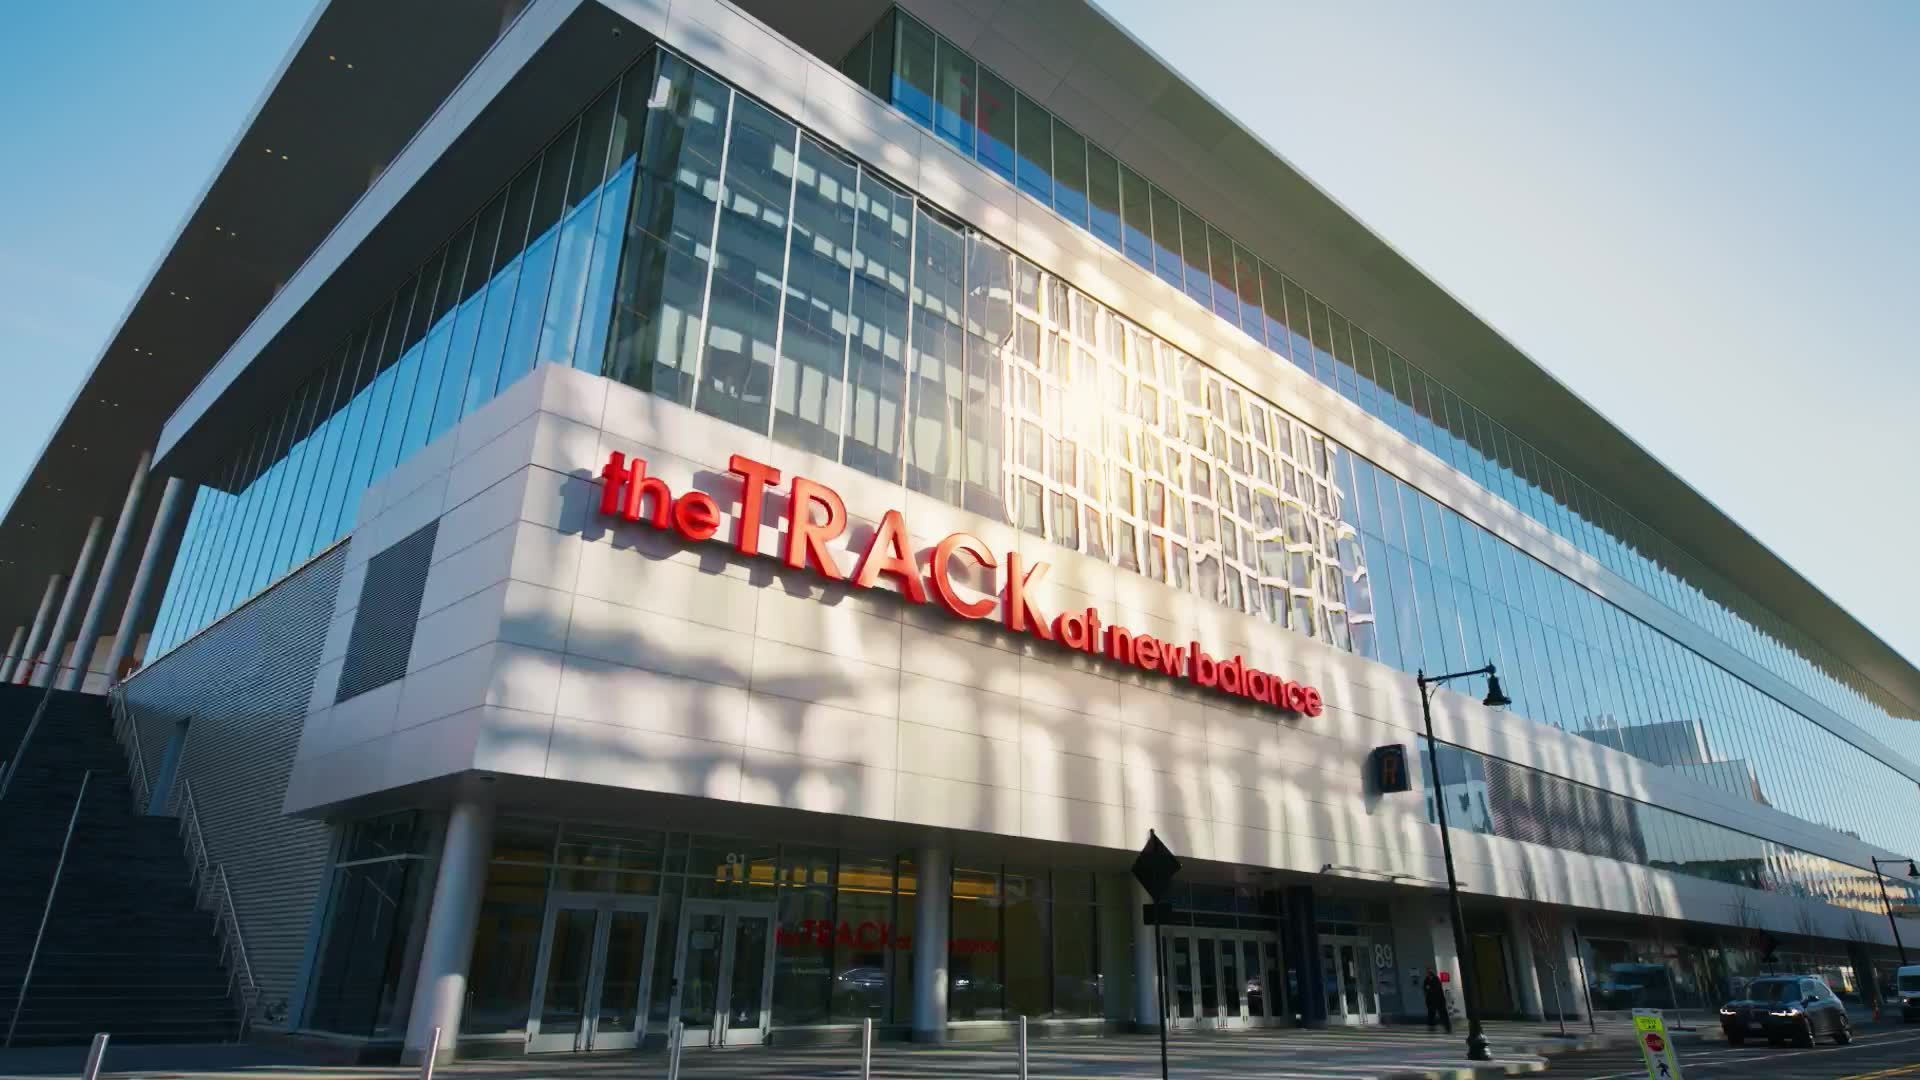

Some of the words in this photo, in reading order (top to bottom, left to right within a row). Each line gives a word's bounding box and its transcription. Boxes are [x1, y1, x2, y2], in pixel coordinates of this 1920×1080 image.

[602, 451, 721, 541] the
[728, 453, 1054, 640] TRACK
[1052, 607, 1102, 654] at
[1107, 624, 1186, 677] new
[1189, 640, 1324, 717] balance
[1375, 943, 1393, 969] 89
